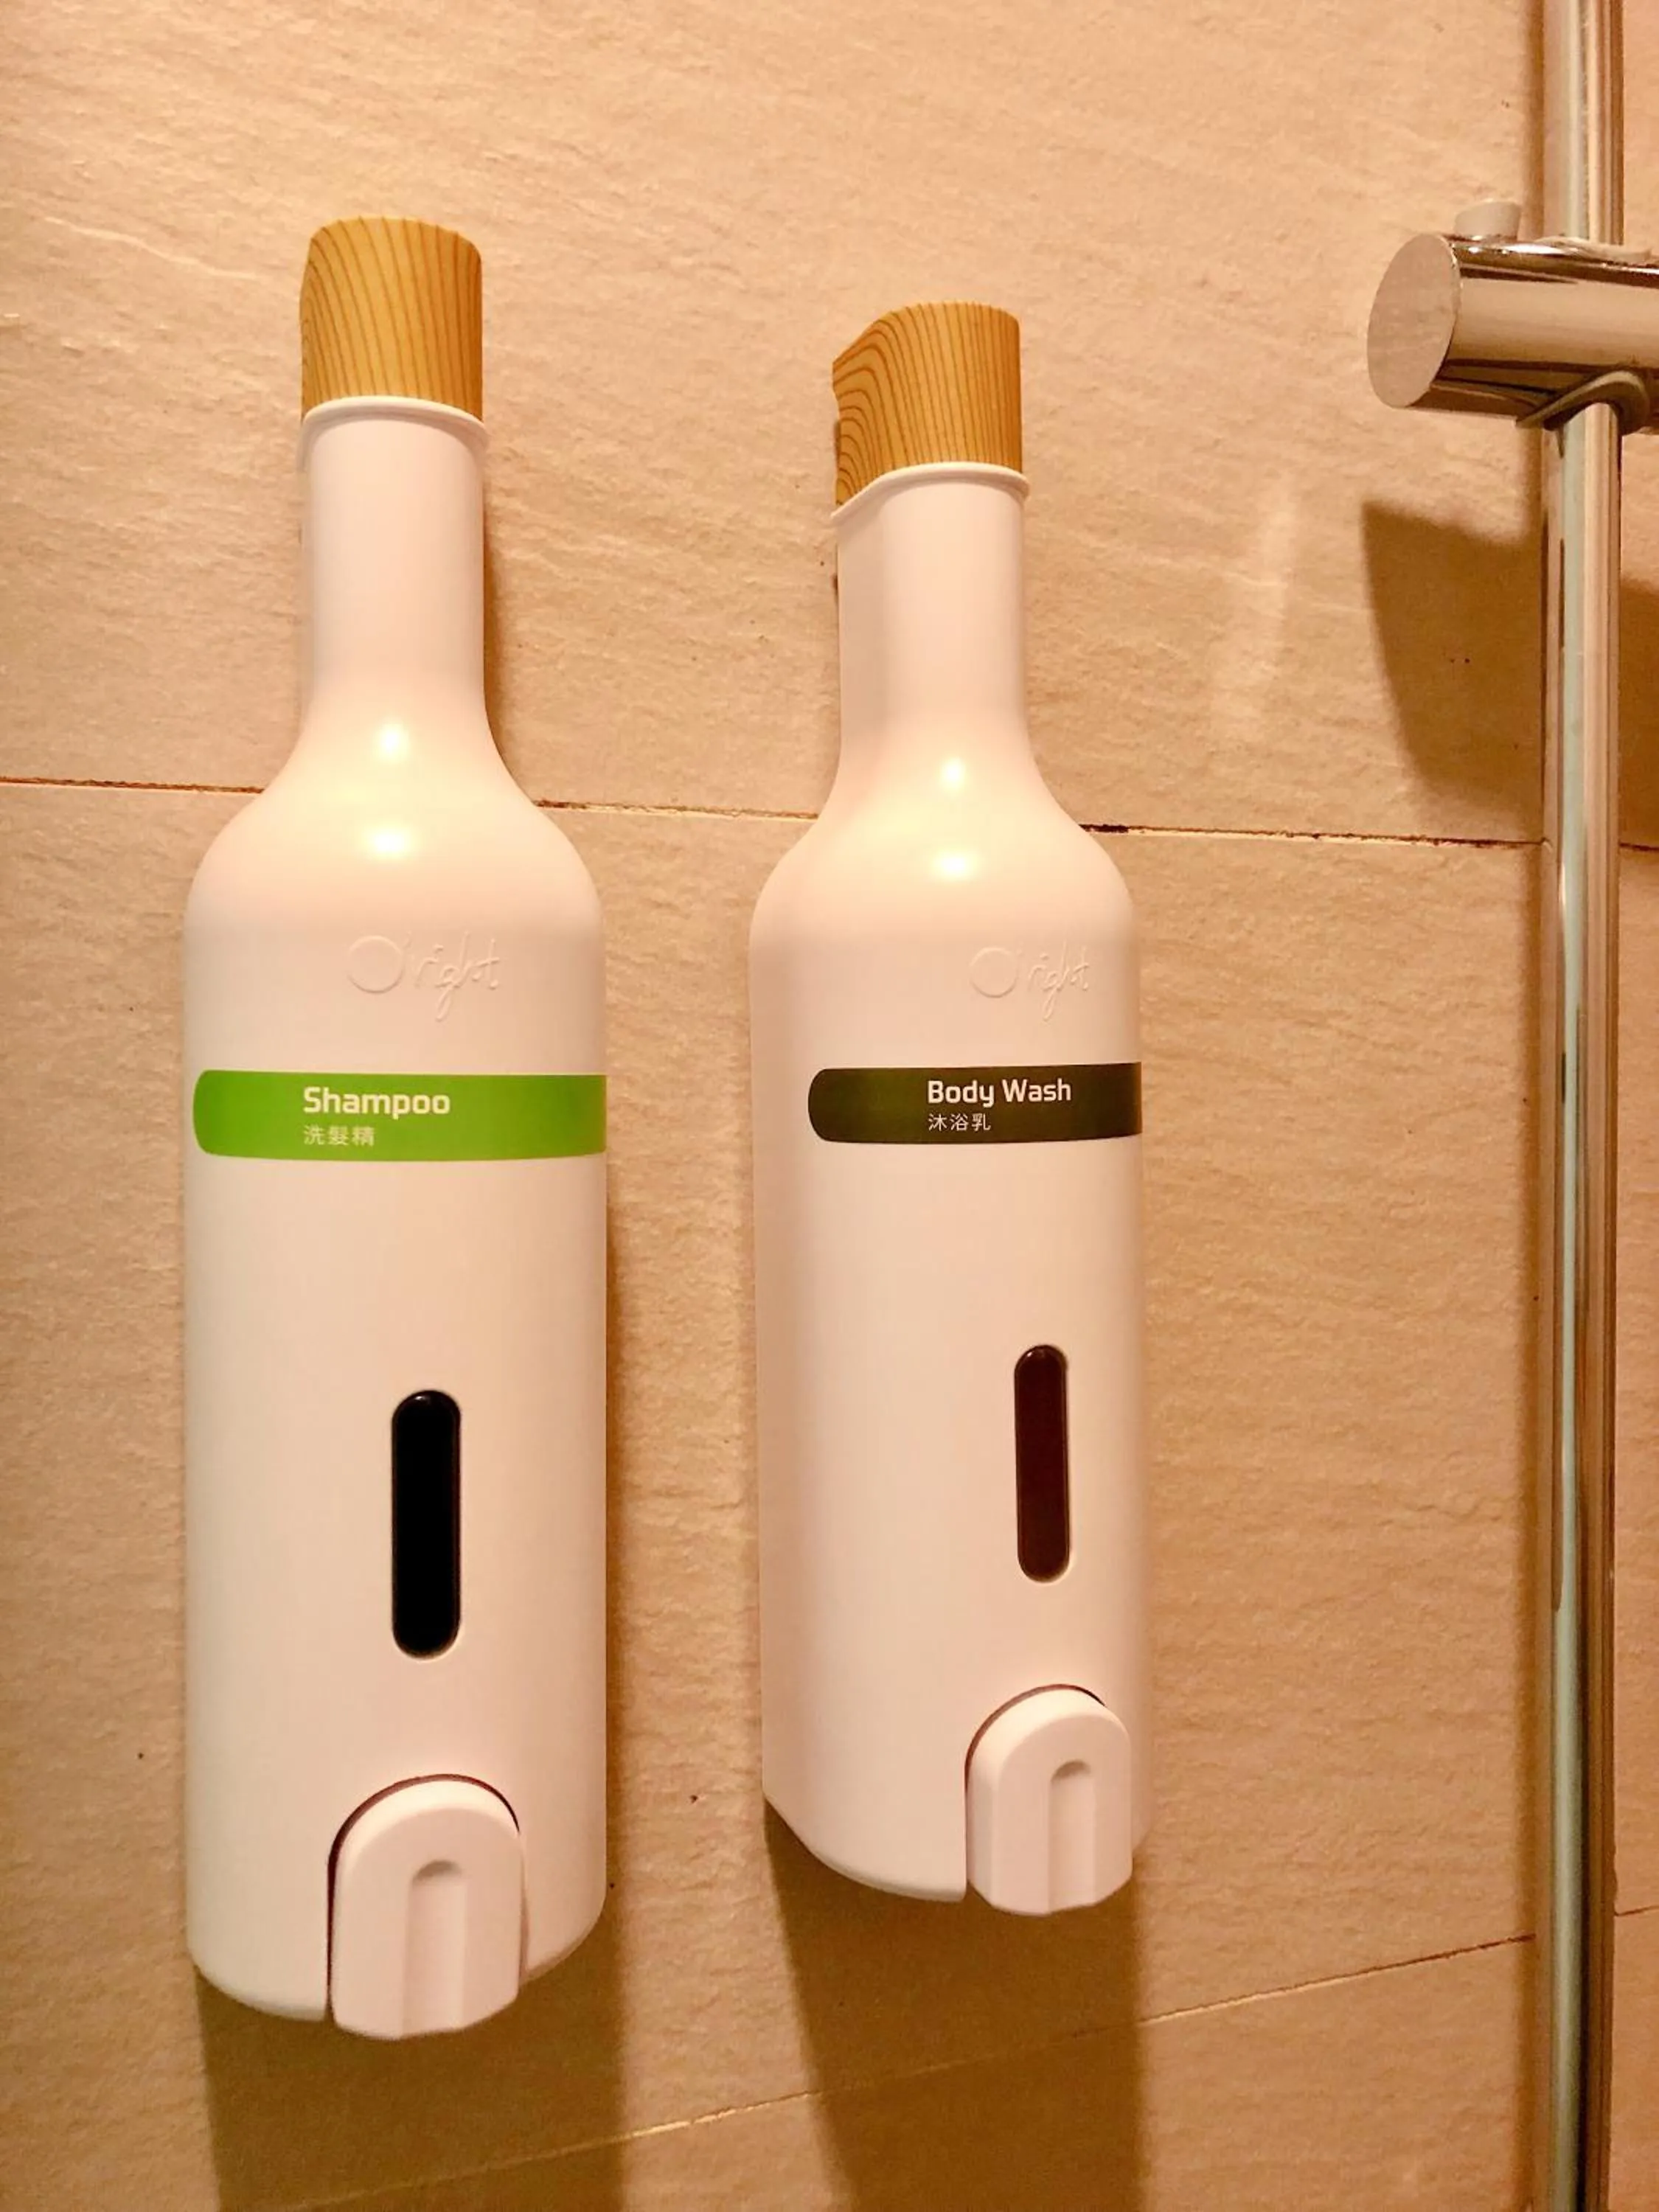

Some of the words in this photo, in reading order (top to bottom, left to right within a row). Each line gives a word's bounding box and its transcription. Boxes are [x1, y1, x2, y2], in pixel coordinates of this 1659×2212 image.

[303, 1086, 451, 1120] Shampoo
[928, 1079, 995, 1108] Body
[1001, 1077, 1072, 1102] Wash
[303, 1124, 375, 1147] 洗髮精
[928, 1112, 991, 1132] 沐浴乳
